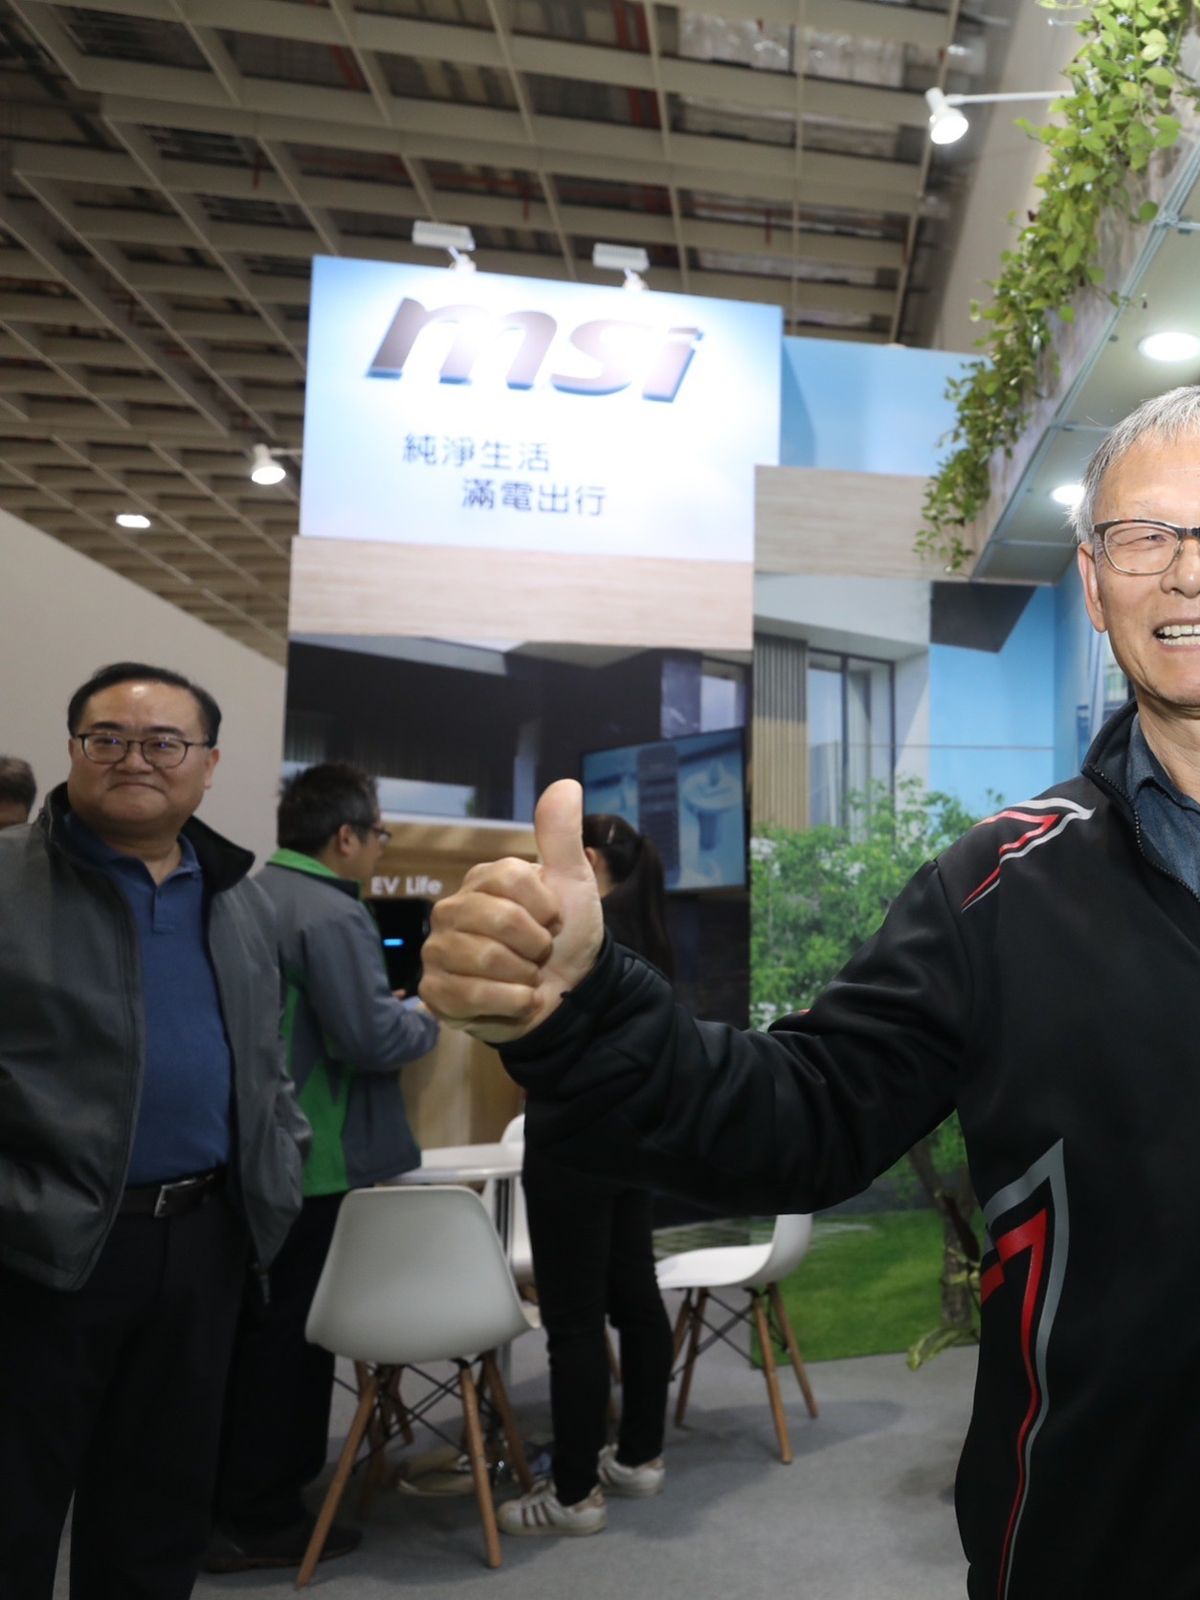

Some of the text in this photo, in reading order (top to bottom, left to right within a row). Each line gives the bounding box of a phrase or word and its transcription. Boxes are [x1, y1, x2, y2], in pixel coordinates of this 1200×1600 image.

[365, 297, 703, 403] msi
[402, 433, 551, 472] 純淨生活
[461, 478, 607, 517] 滿電出行
[371, 875, 443, 895] EV Life
